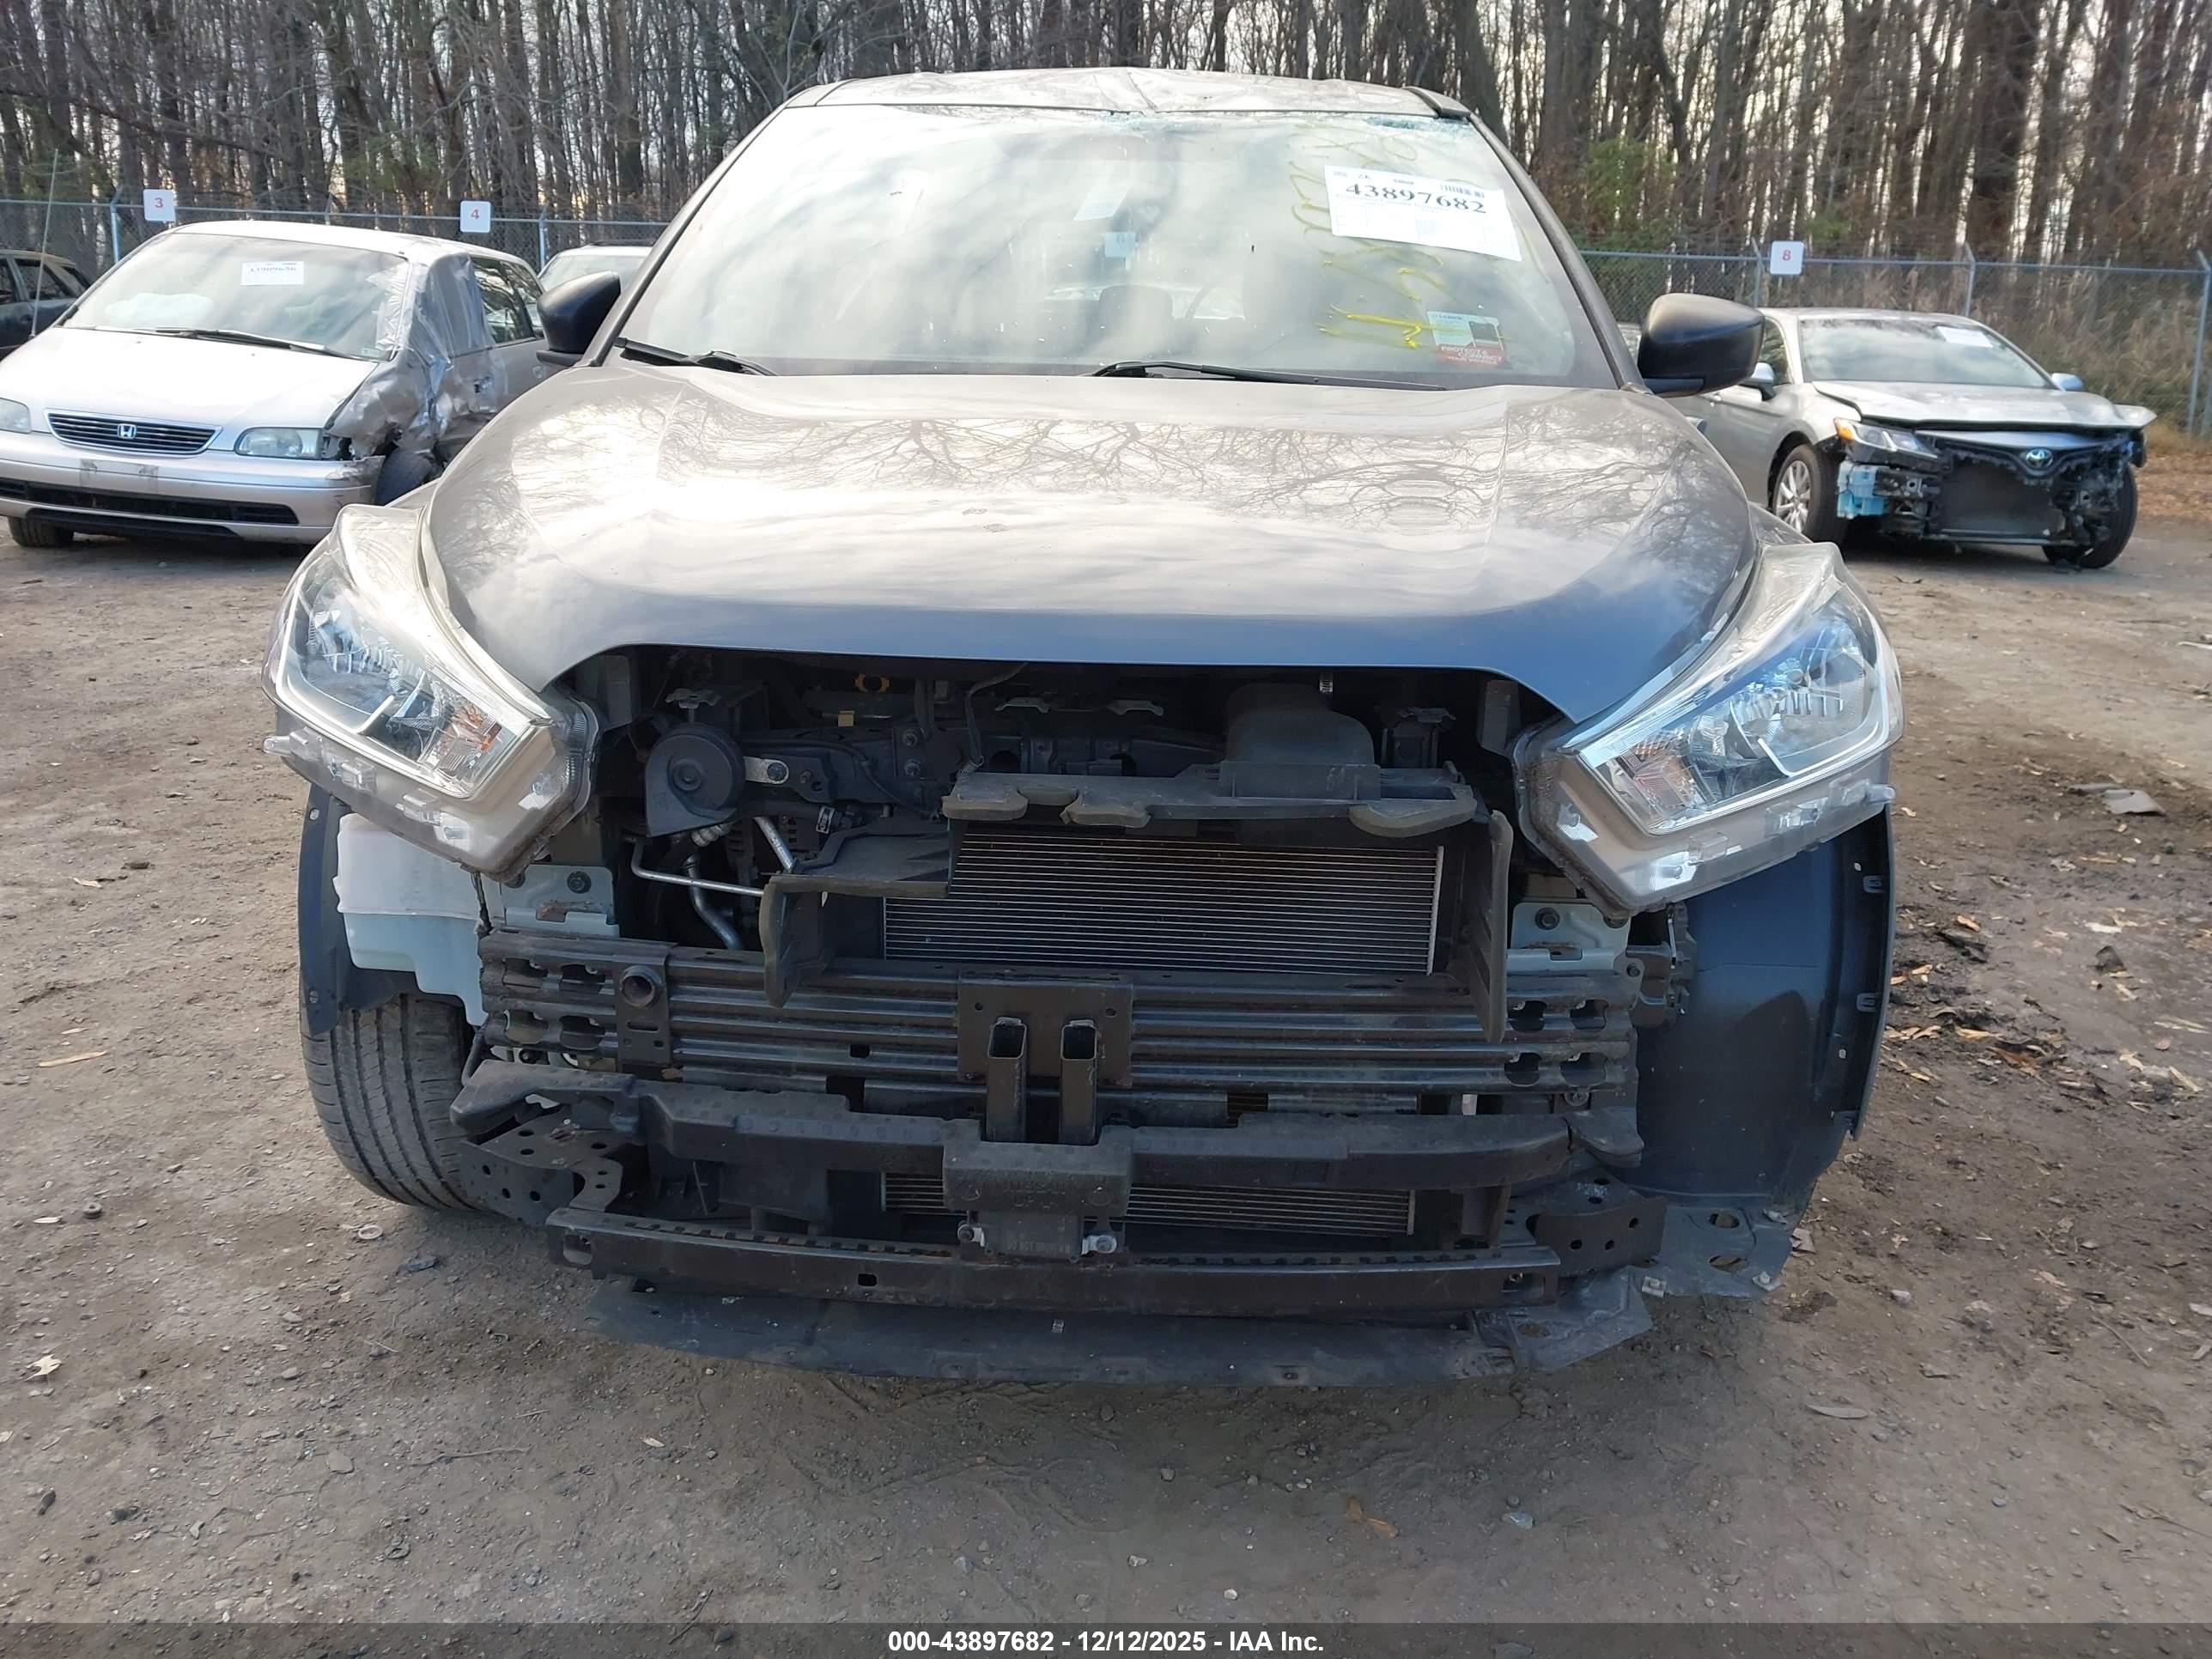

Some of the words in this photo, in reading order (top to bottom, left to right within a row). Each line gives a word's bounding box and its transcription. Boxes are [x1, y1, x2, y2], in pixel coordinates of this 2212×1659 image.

[155, 197, 164, 209] 3
[1346, 183, 1486, 214] 43897682
[471, 209, 480, 220] 4
[1782, 249, 1791, 261] 8
